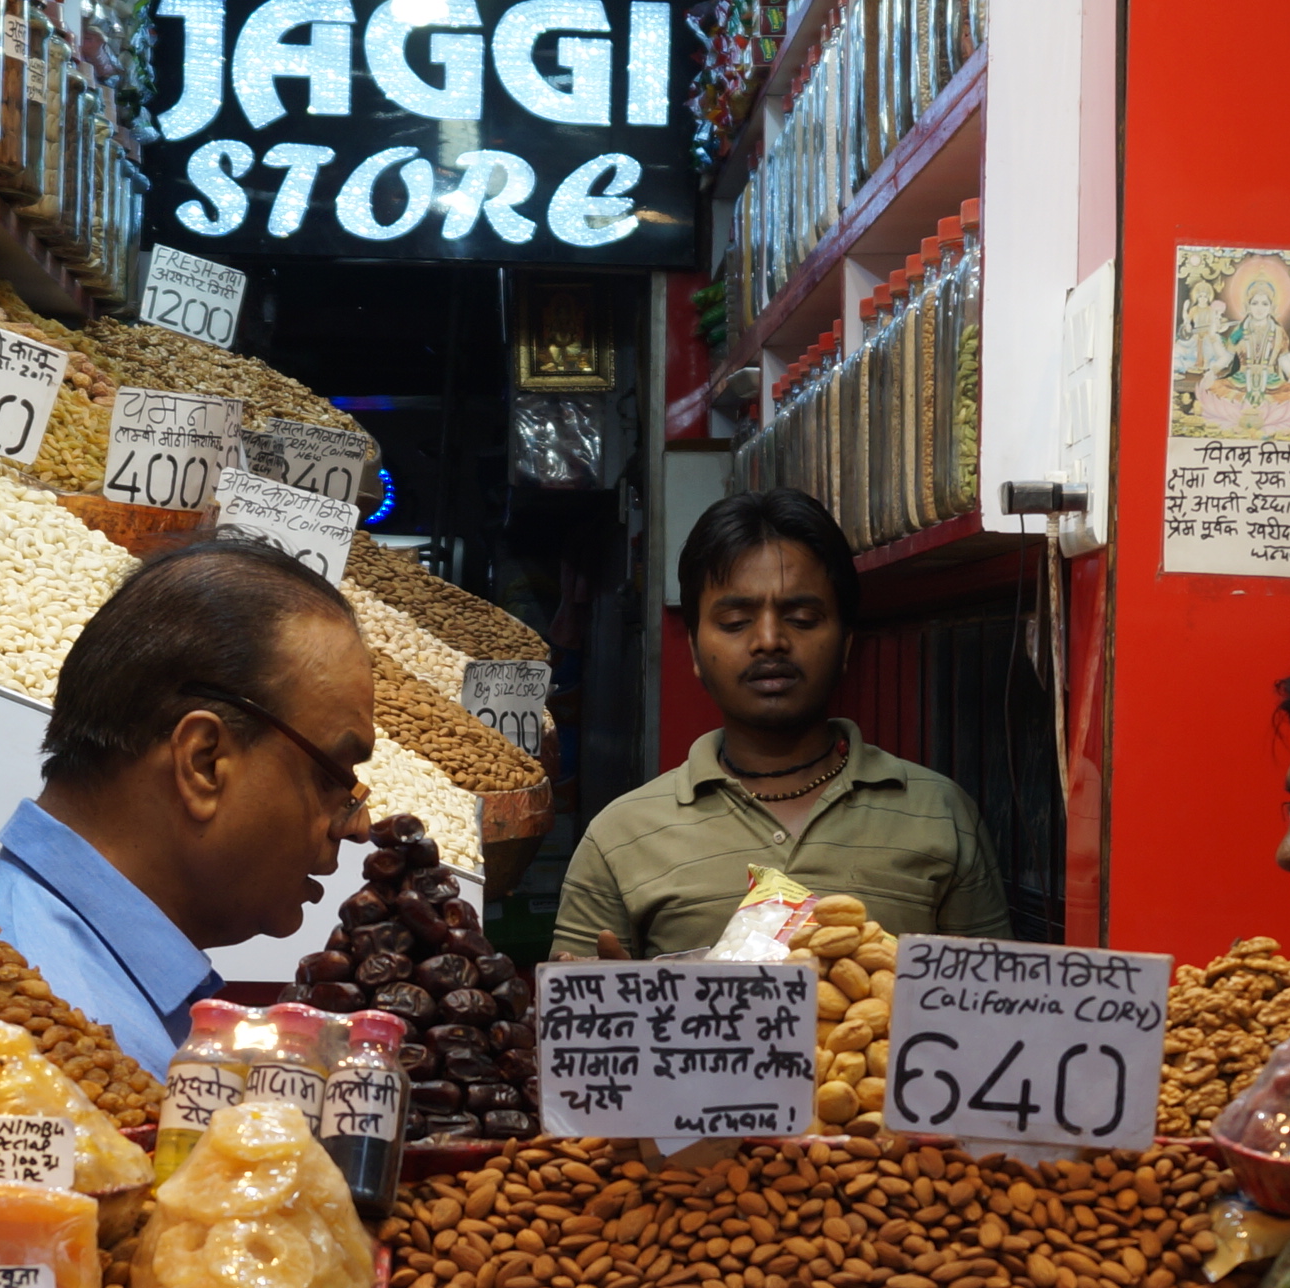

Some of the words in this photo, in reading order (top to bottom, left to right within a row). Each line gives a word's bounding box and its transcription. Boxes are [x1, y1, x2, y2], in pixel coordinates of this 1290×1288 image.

[157, 0, 671, 141] JAGGI
[146, 285, 234, 343] 1200
[107, 450, 209, 509] 400
[1189, 493, 1246, 515] अपनी
[549, 974, 605, 1004] आप
[616, 968, 686, 1003] सभी
[783, 969, 807, 1004] से
[1058, 952, 1142, 994] गिरी
[541, 1004, 638, 1041] निवेदन
[680, 1004, 745, 1041] कोई
[756, 1005, 801, 1041] भी
[551, 1047, 640, 1078] सामान
[894, 1032, 1127, 1137] 640
